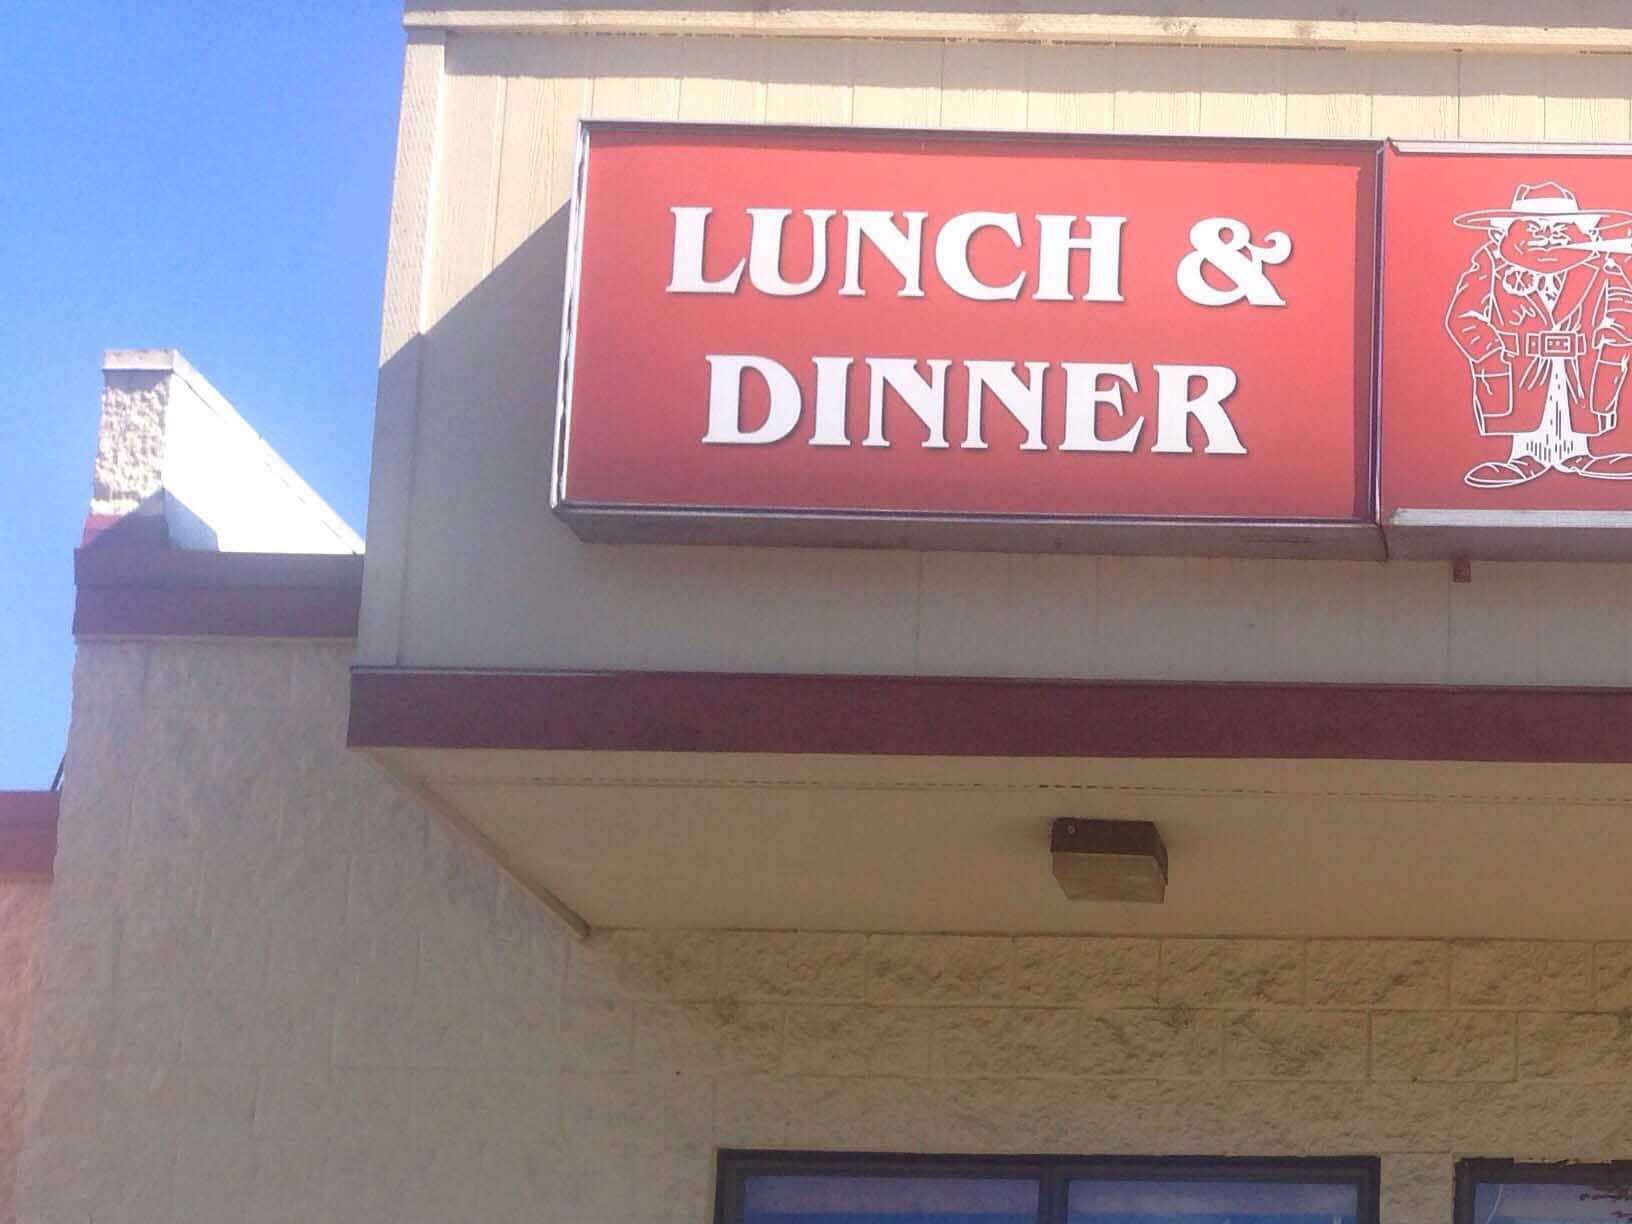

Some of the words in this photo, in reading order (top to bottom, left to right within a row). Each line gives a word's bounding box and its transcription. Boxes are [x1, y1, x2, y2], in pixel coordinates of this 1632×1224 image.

[666, 206, 1127, 302] LUNCH
[1176, 217, 1293, 307] &
[701, 354, 1248, 456] DINNER
